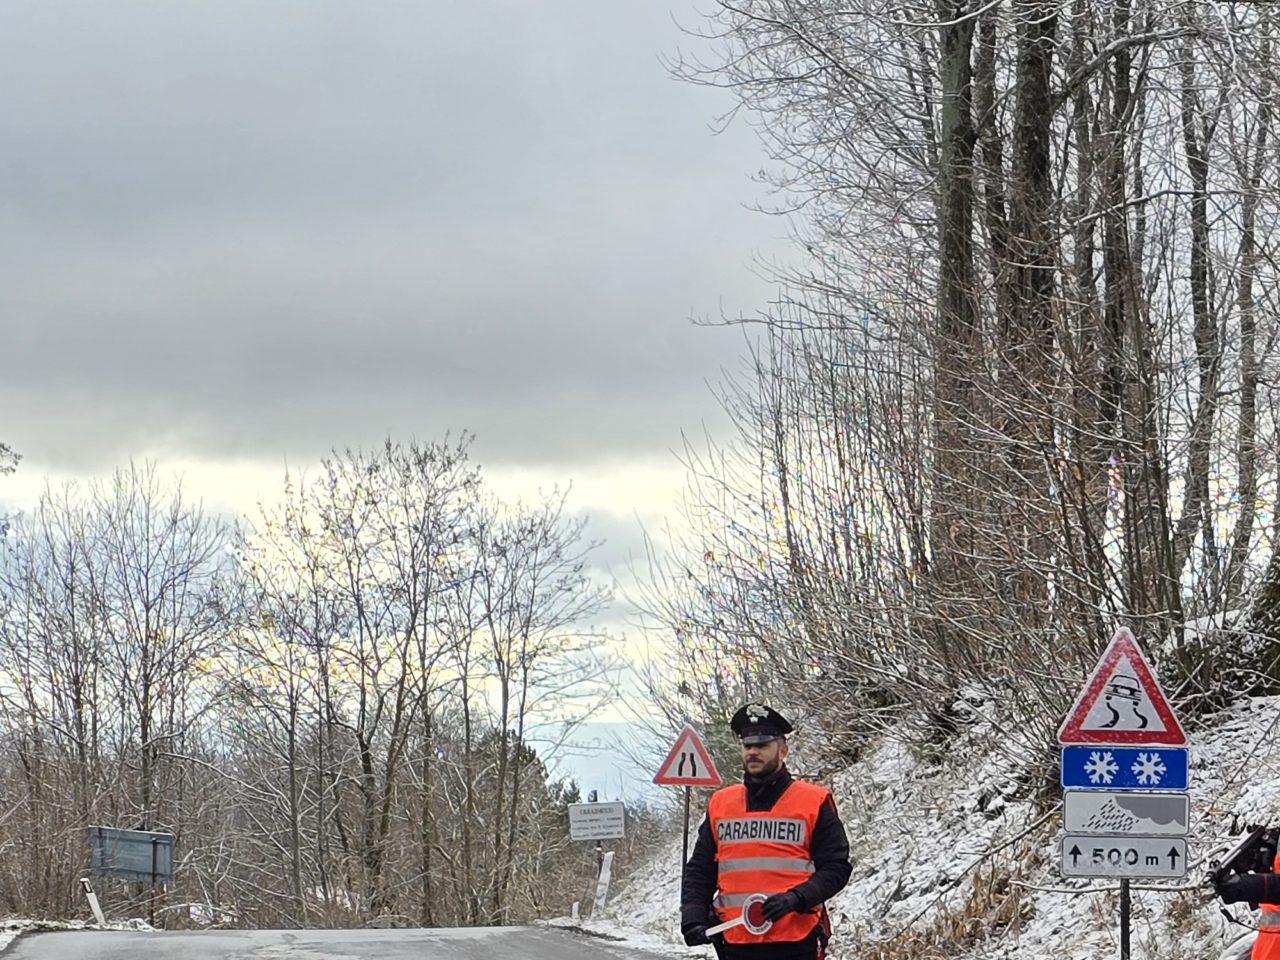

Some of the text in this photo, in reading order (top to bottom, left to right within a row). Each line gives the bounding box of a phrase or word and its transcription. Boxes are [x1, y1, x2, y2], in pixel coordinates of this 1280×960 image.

[717, 820, 801, 842] CARABINIERI
[1092, 848, 1159, 866] 500 m
